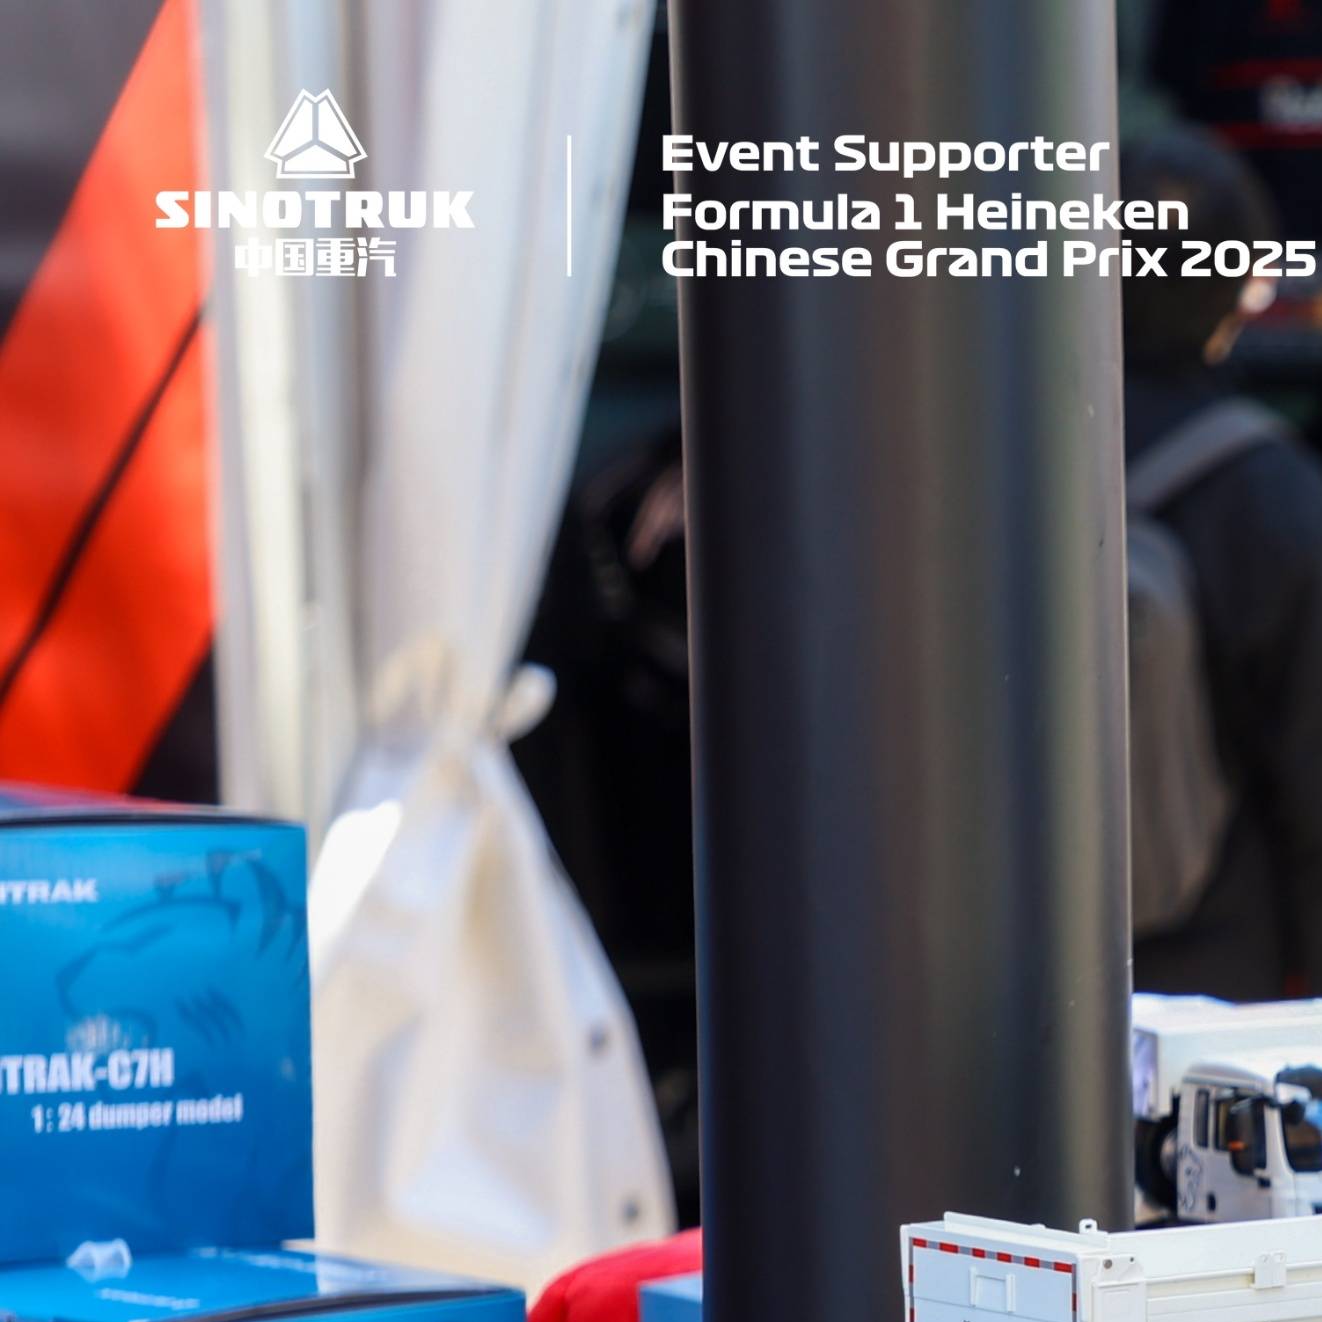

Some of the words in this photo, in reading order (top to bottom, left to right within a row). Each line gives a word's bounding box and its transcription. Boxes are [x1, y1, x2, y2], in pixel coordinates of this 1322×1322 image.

[0, 1047, 174, 1095] TRAK-C7H
[88, 1100, 173, 1131] dumper
[175, 1093, 243, 1126] model
